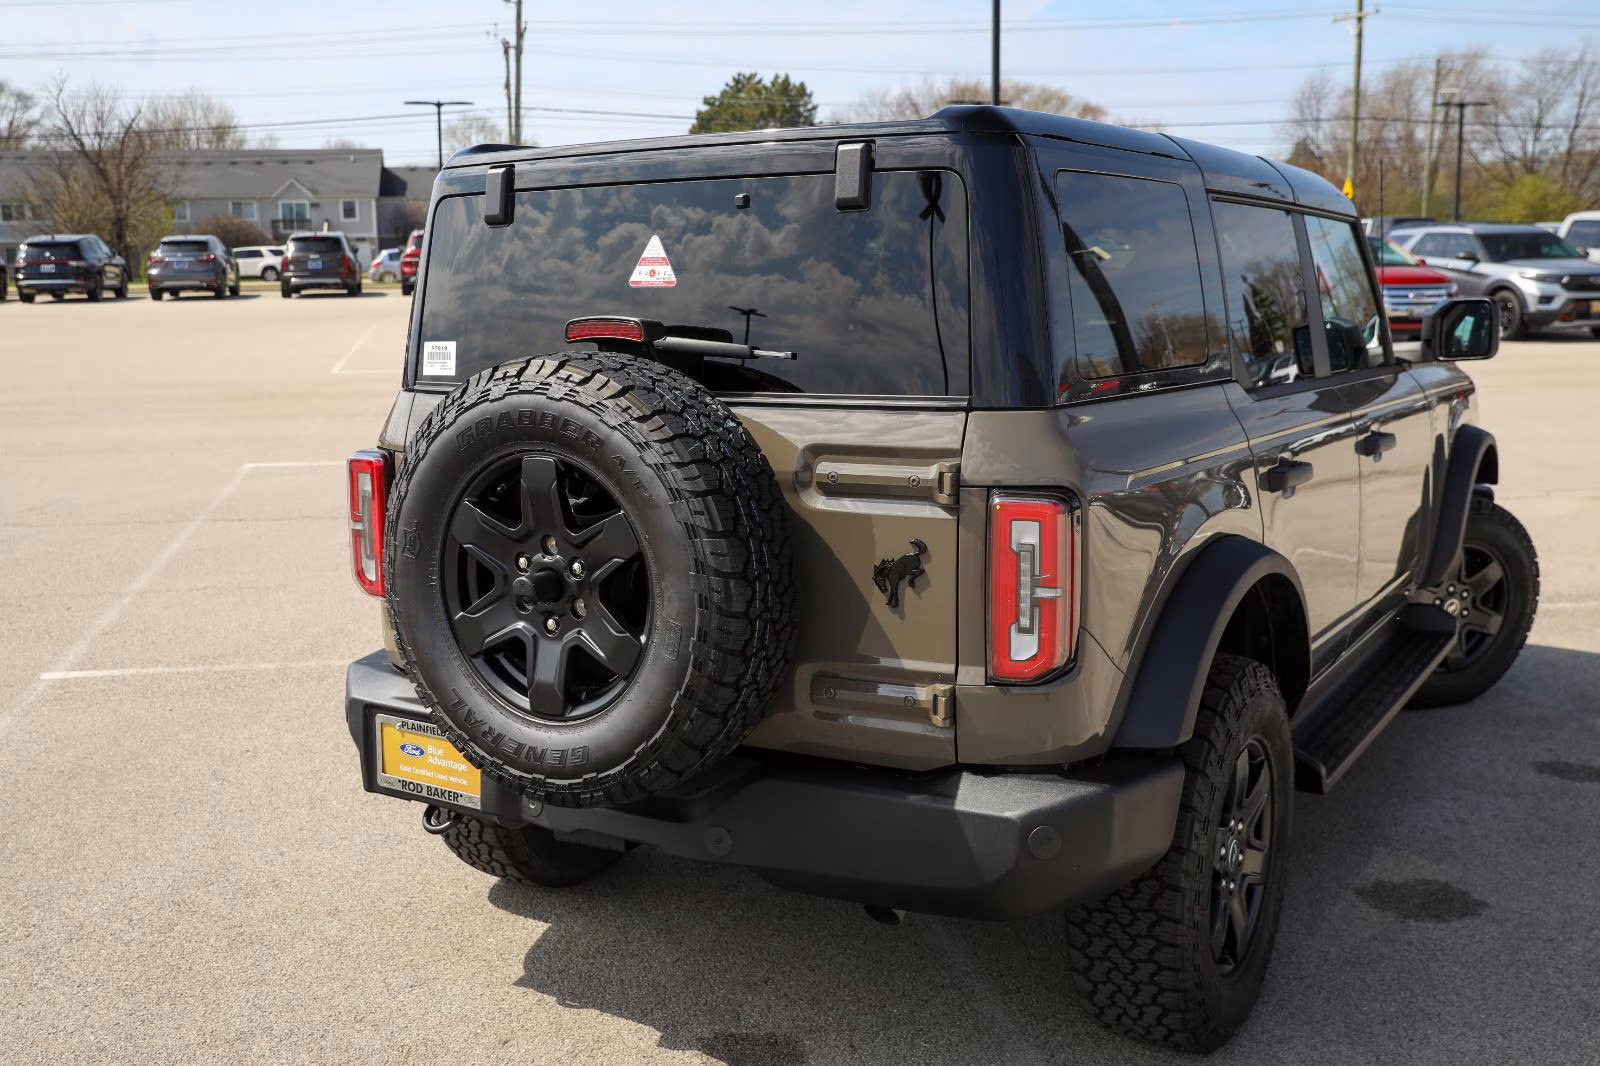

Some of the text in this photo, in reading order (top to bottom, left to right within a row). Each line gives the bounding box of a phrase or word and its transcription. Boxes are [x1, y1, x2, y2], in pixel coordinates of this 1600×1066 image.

[455, 408, 604, 455] GRABBER
[449, 687, 590, 767] GENERAL
[428, 744, 444, 755] Blue
[428, 755, 467, 772] Advantage
[412, 767, 433, 777] Certified
[434, 772, 448, 781] Used
[449, 775, 467, 785] Vehicle
[401, 780, 423, 794] ROD
[427, 786, 460, 803] BAKER
